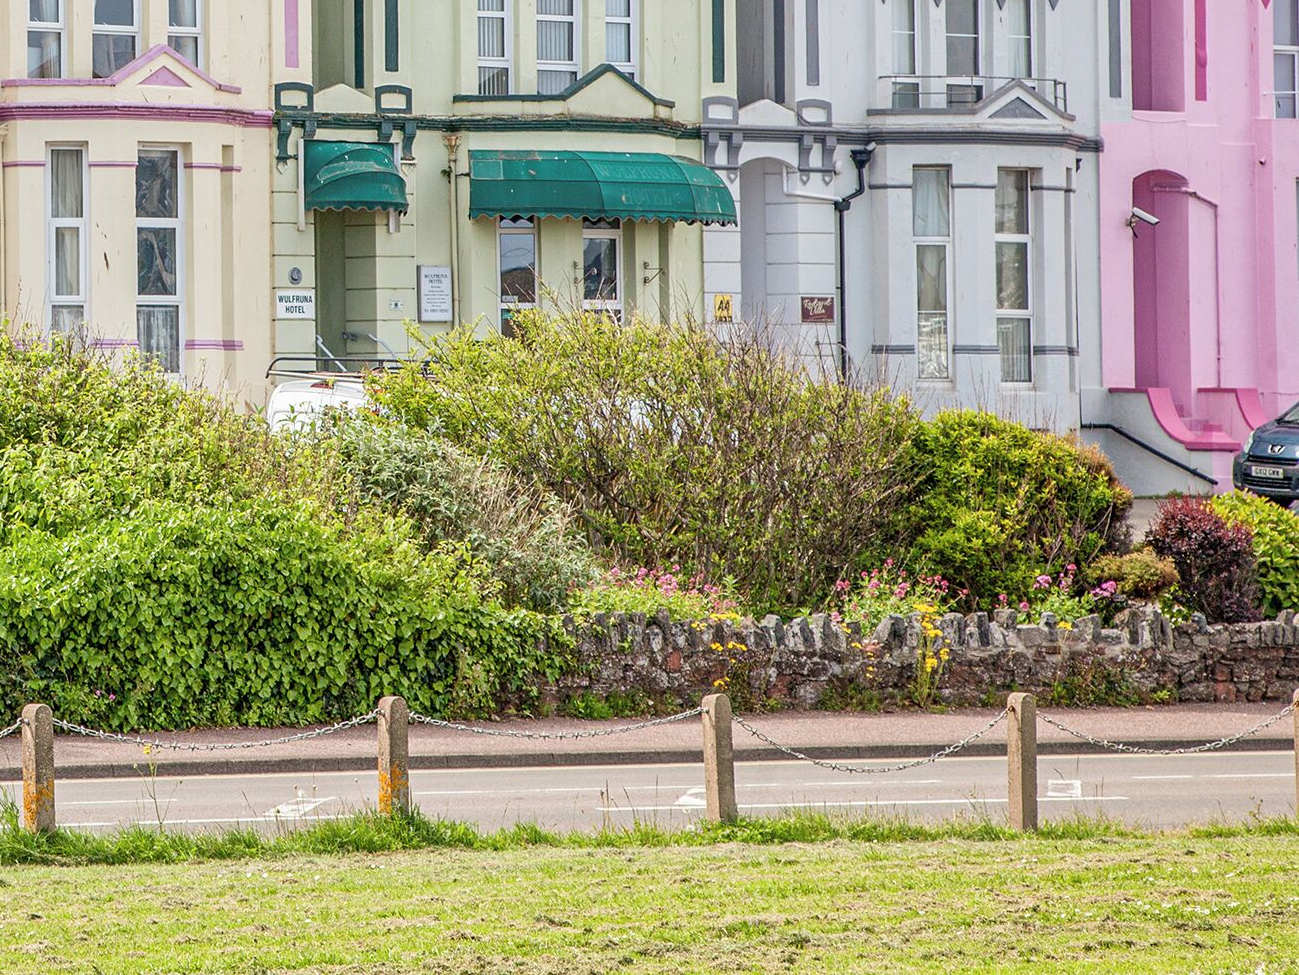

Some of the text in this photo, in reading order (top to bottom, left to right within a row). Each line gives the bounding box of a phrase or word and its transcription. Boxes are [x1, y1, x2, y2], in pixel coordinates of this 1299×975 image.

[621, 187, 673, 206] HOTEL
[277, 295, 313, 304] WULFRUNA
[285, 305, 306, 314] HOTEL
